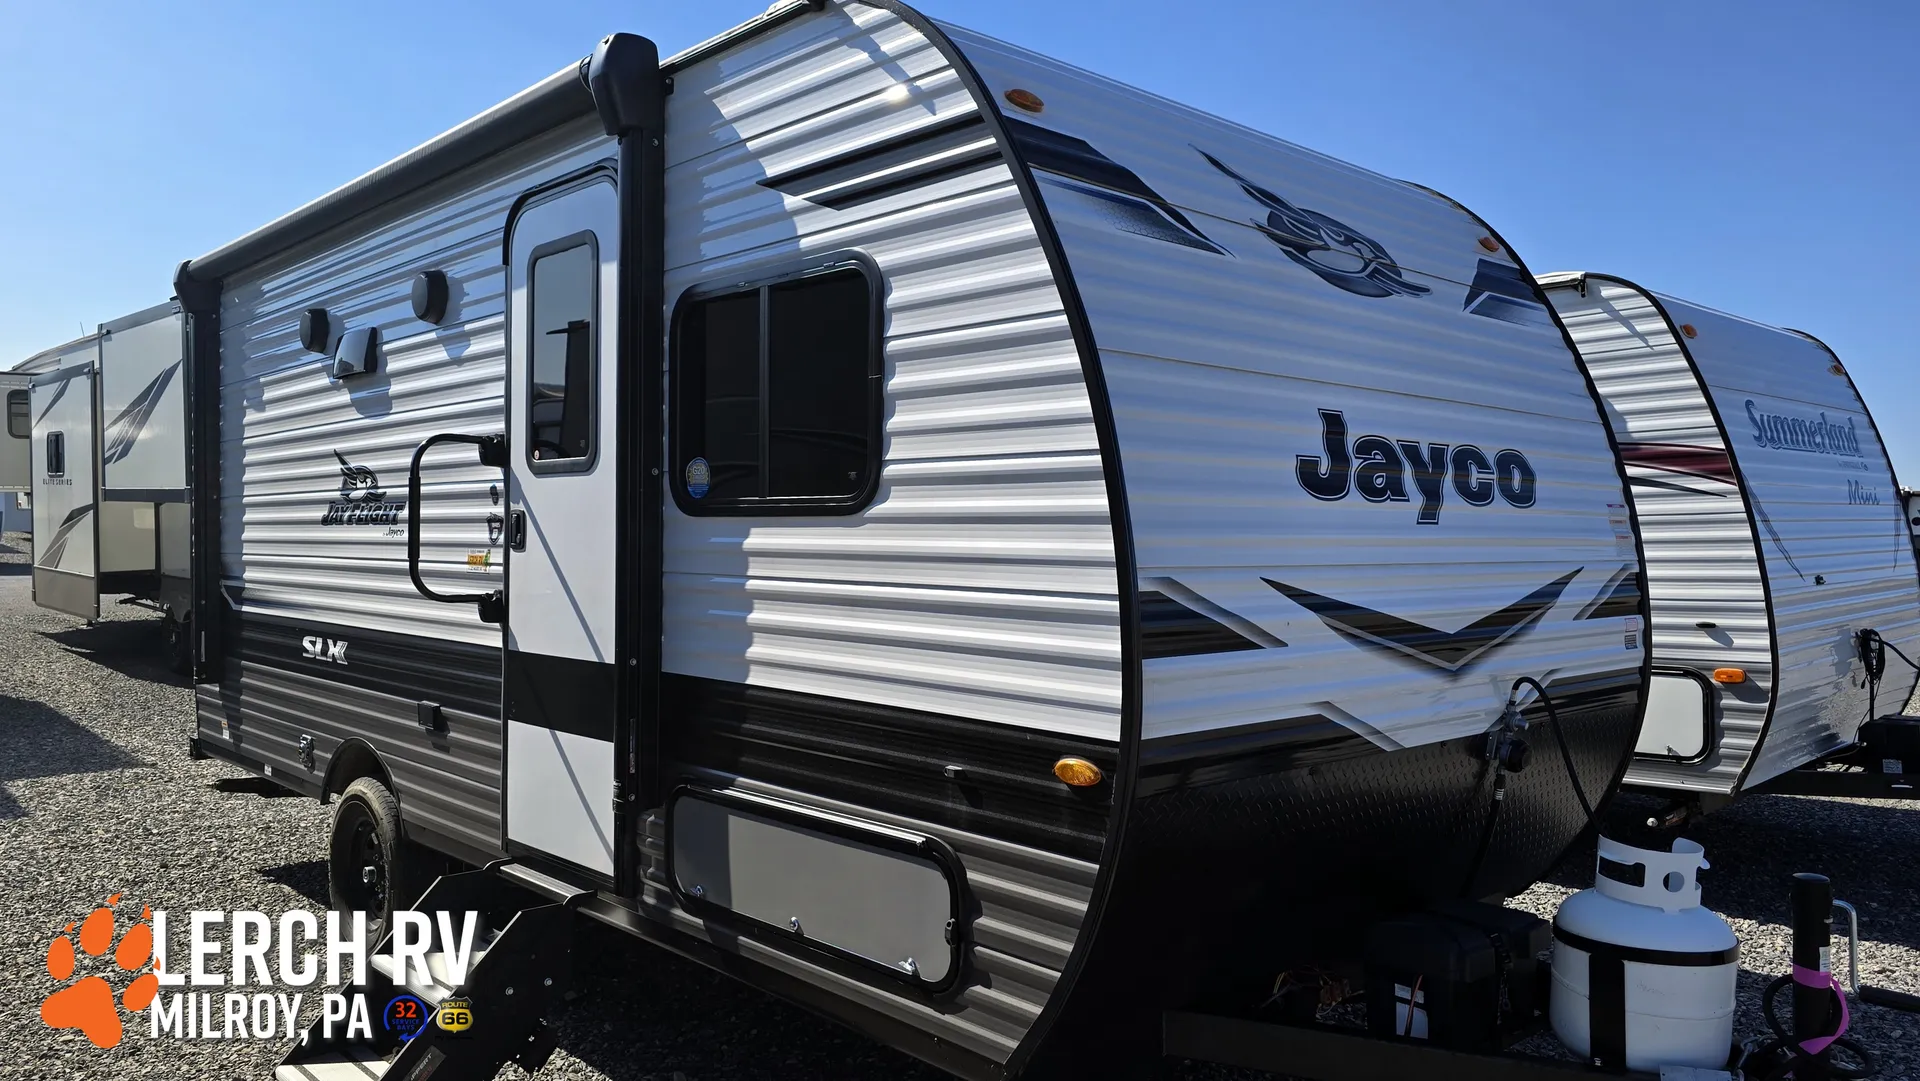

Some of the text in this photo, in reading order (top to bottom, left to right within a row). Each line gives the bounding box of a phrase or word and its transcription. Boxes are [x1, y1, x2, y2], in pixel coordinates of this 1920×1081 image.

[1744, 399, 1864, 459] Summerland
[1295, 407, 1537, 525] Jayco
[42, 478, 73, 486] ELITE SERIES
[1847, 478, 1881, 506] Mini
[320, 501, 407, 526] JAY FLIGHT
[386, 526, 405, 539] Jayco
[302, 635, 349, 665] SLX
